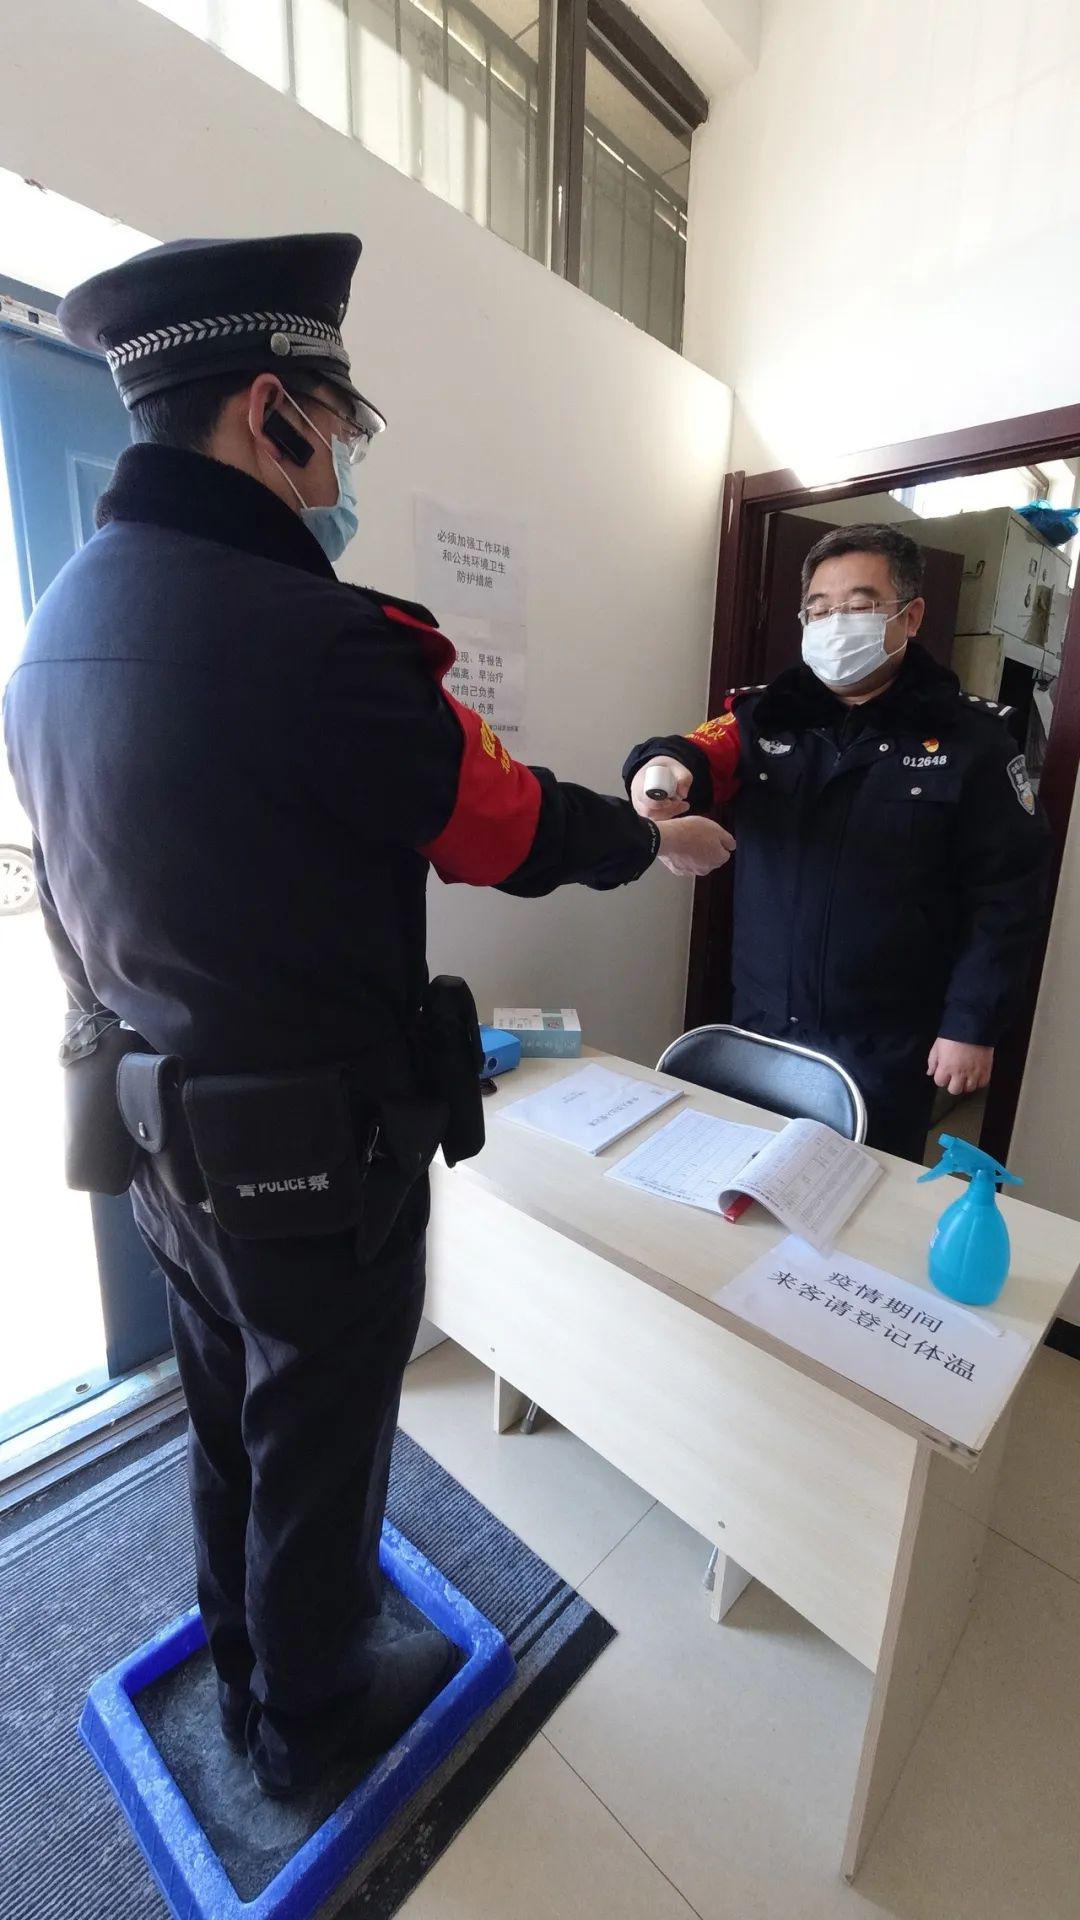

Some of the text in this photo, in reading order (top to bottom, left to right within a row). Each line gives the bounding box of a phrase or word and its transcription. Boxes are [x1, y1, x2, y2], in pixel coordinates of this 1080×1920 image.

[437, 529, 511, 559] 必须加强工作环境
[442, 549, 506, 574] 和公共环境卫生
[456, 569, 493, 589] 防护措施
[451, 684, 495, 699] 对自己负责
[902, 755, 947, 768] 012648
[824, 1271, 944, 1334] 疫情期间
[767, 1270, 976, 1383] 来客请登记体温
